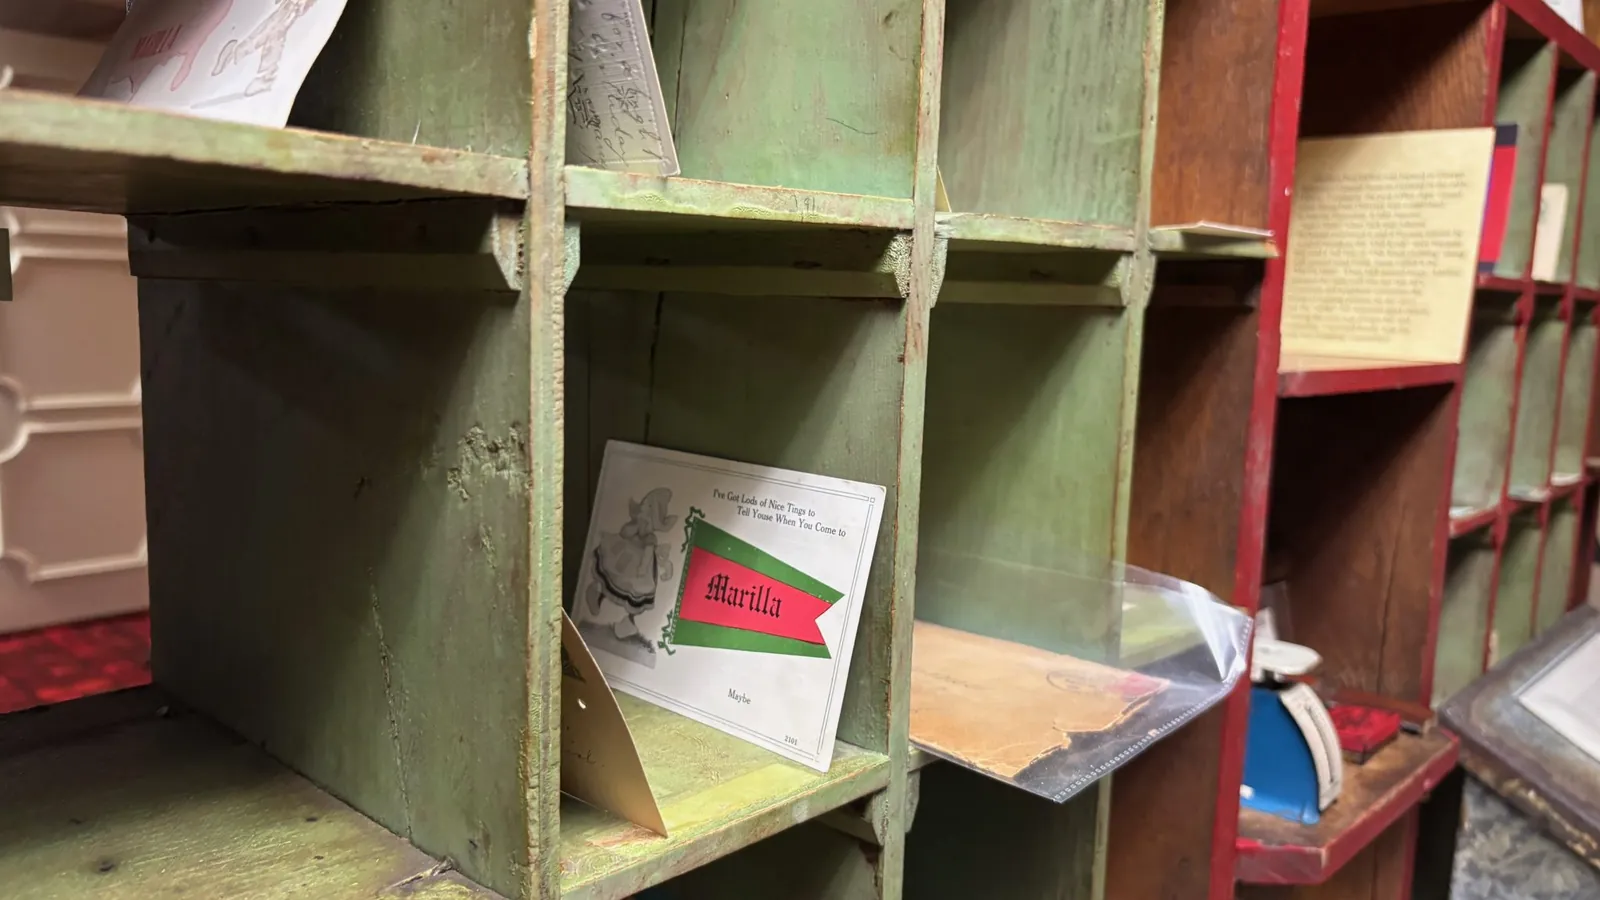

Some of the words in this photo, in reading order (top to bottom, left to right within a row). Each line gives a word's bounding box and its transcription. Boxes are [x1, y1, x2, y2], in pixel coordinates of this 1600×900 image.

[713, 489, 726, 500] I've
[727, 491, 740, 502] Got
[741, 494, 758, 506] Lods
[760, 498, 768, 508] of
[769, 500, 785, 511] Nice
[787, 502, 806, 517] Tings
[808, 509, 816, 517] to
[737, 505, 750, 517] Tell
[752, 509, 773, 522] Youse
[775, 513, 796, 527] When
[799, 518, 813, 530] You
[815, 522, 837, 535] Come
[838, 529, 847, 538] to
[705, 572, 782, 619] Marilla
[728, 687, 751, 704] Maybe
[784, 735, 798, 746] 2101
